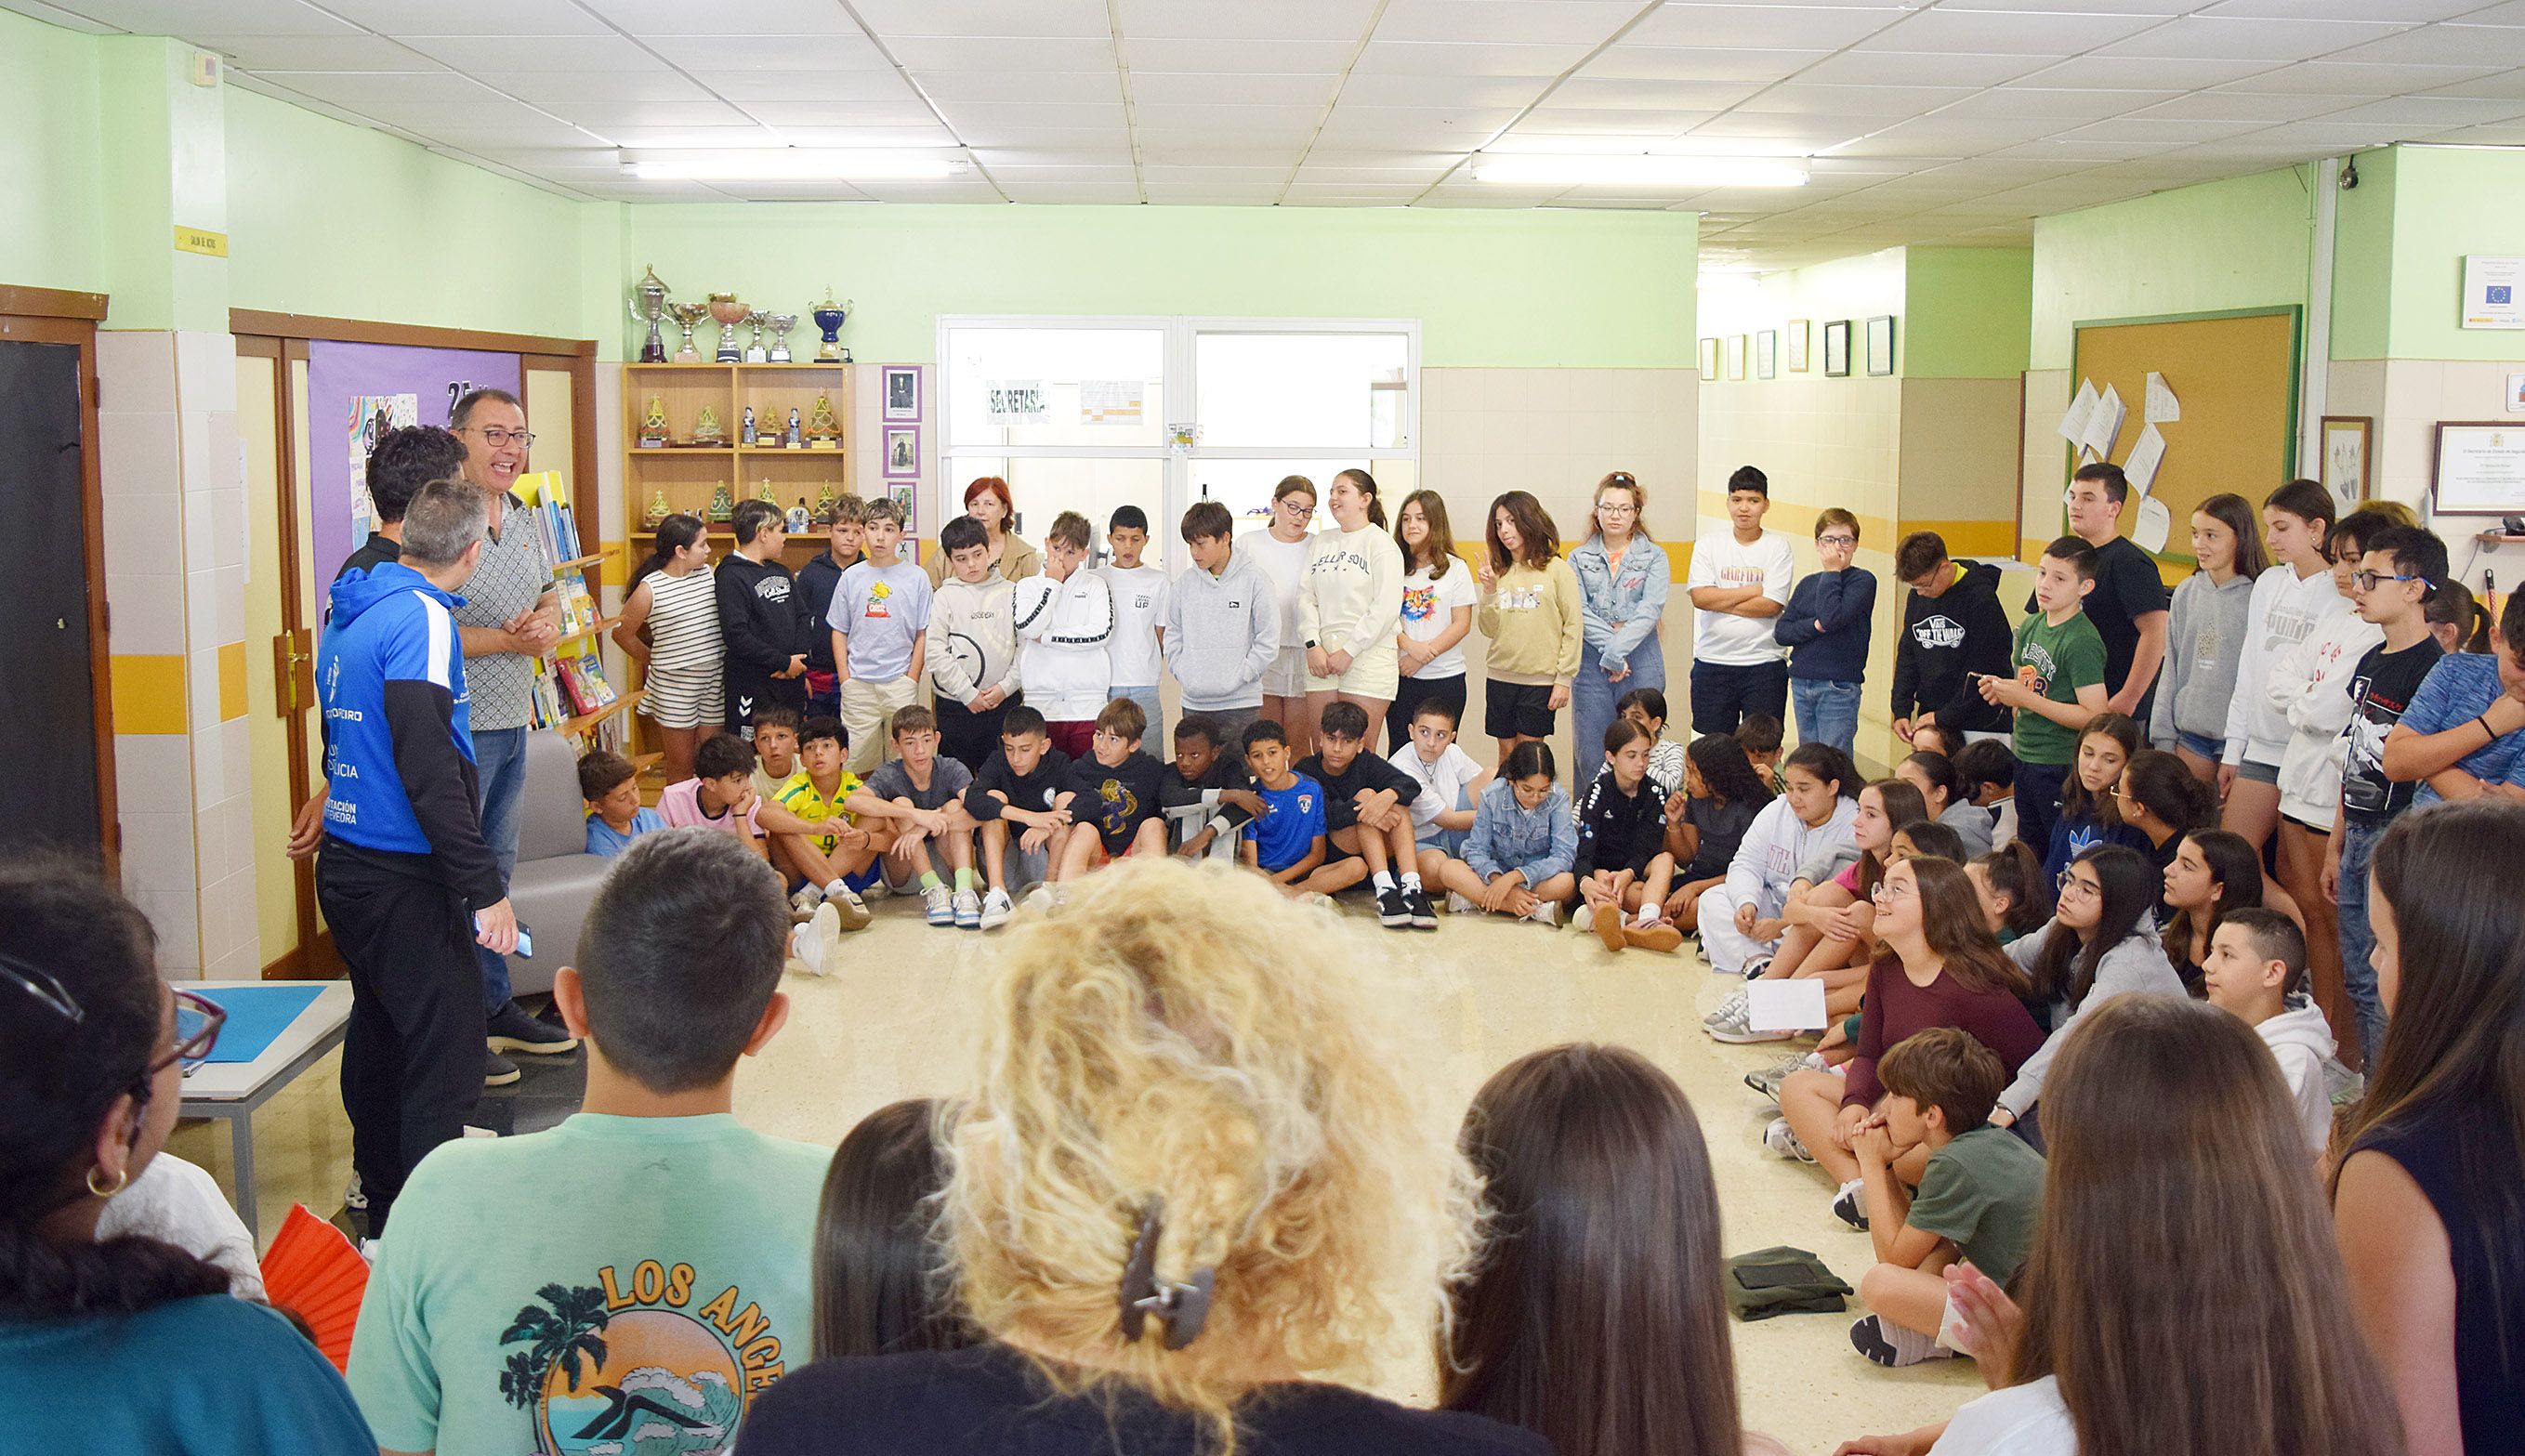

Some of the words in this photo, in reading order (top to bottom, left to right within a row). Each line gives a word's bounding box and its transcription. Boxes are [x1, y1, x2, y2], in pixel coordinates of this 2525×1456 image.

[1347, 554, 1371, 575] SOUL
[822, 834, 835, 850] 9
[598, 1258, 696, 1312] LOS
